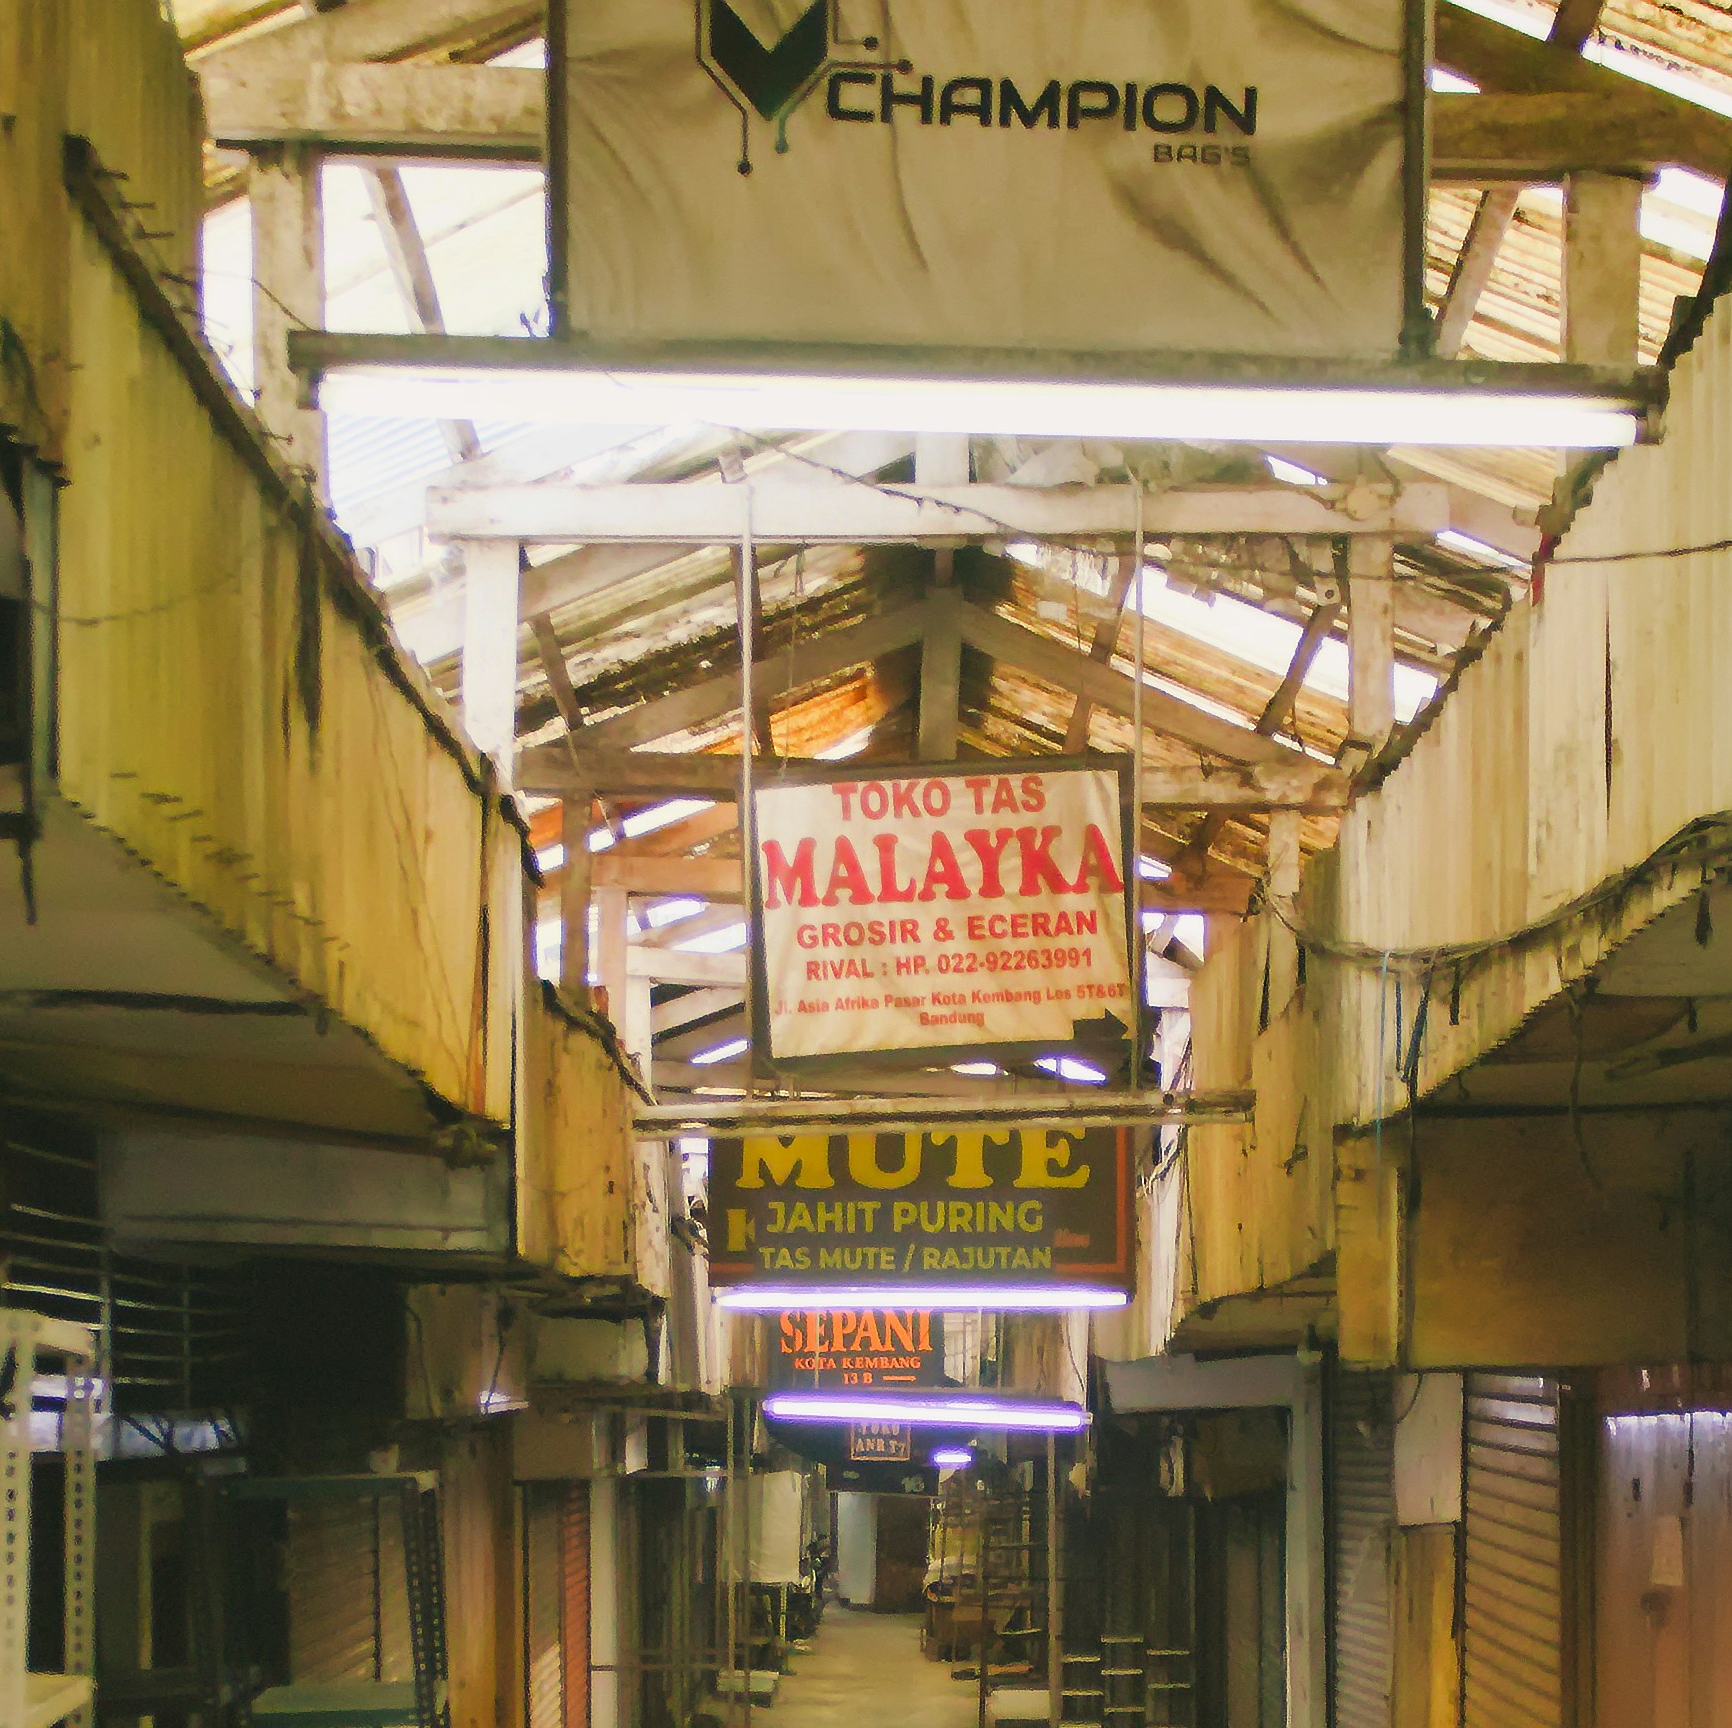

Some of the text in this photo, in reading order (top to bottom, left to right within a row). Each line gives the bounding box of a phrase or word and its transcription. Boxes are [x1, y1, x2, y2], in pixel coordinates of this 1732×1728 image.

[826, 70, 1258, 136] CHAMPION
[1153, 143, 1251, 166] BAG'S
[832, 774, 1047, 821] TOKO TAS
[760, 823, 1126, 911] MALAYKA
[796, 909, 1098, 949] GROSIR & ECERAN
[806, 957, 875, 981] RIVAL
[896, 954, 930, 977] HP.
[937, 946, 1093, 974] 022-92263991
[797, 999, 830, 1014] Asia
[834, 996, 880, 1012] Afrika
[884, 993, 927, 1008] Pasar
[931, 991, 967, 1006] Kota
[971, 988, 1042, 1006] Kembang
[919, 1011, 985, 1028] Bandung
[735, 1126, 1091, 1190] MUTE
[767, 1199, 1045, 1234] JAHIT PURING
[759, 1246, 811, 1271] TAS
[818, 1246, 897, 1271] MUTE
[922, 1246, 1052, 1271] RAJUTAN
[779, 1309, 934, 1354] SEPANI
[794, 1356, 921, 1370] KOTA KEMBANG
